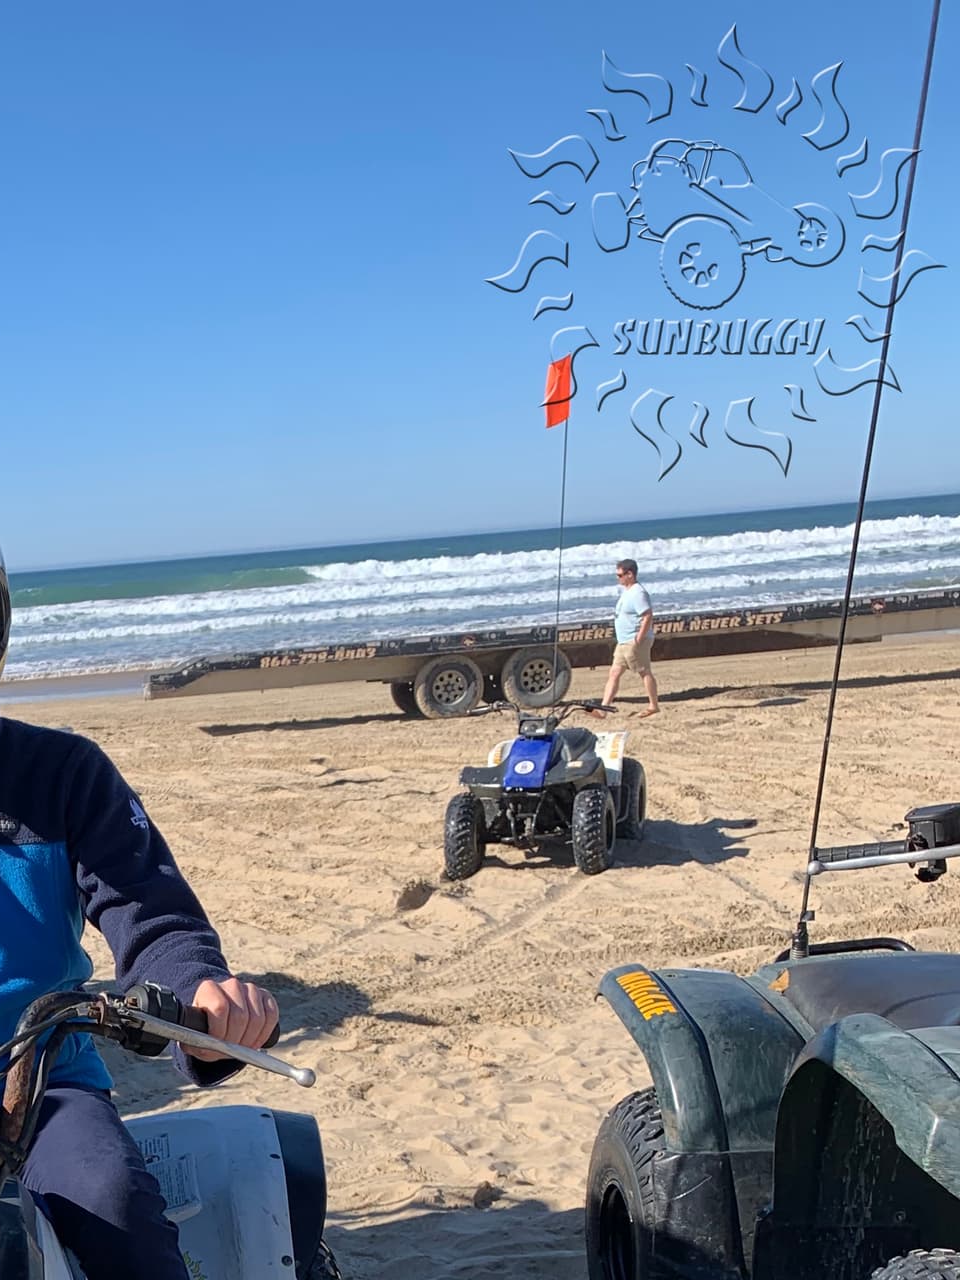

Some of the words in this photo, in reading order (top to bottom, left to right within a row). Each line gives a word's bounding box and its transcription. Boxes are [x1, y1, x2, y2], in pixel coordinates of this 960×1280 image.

[558, 626, 614, 643] WHERE
[653, 620, 685, 634] FUN
[689, 617, 741, 632] NEVER
[745, 611, 784, 626] SETS
[615, 971, 678, 1021] MAGGIE
